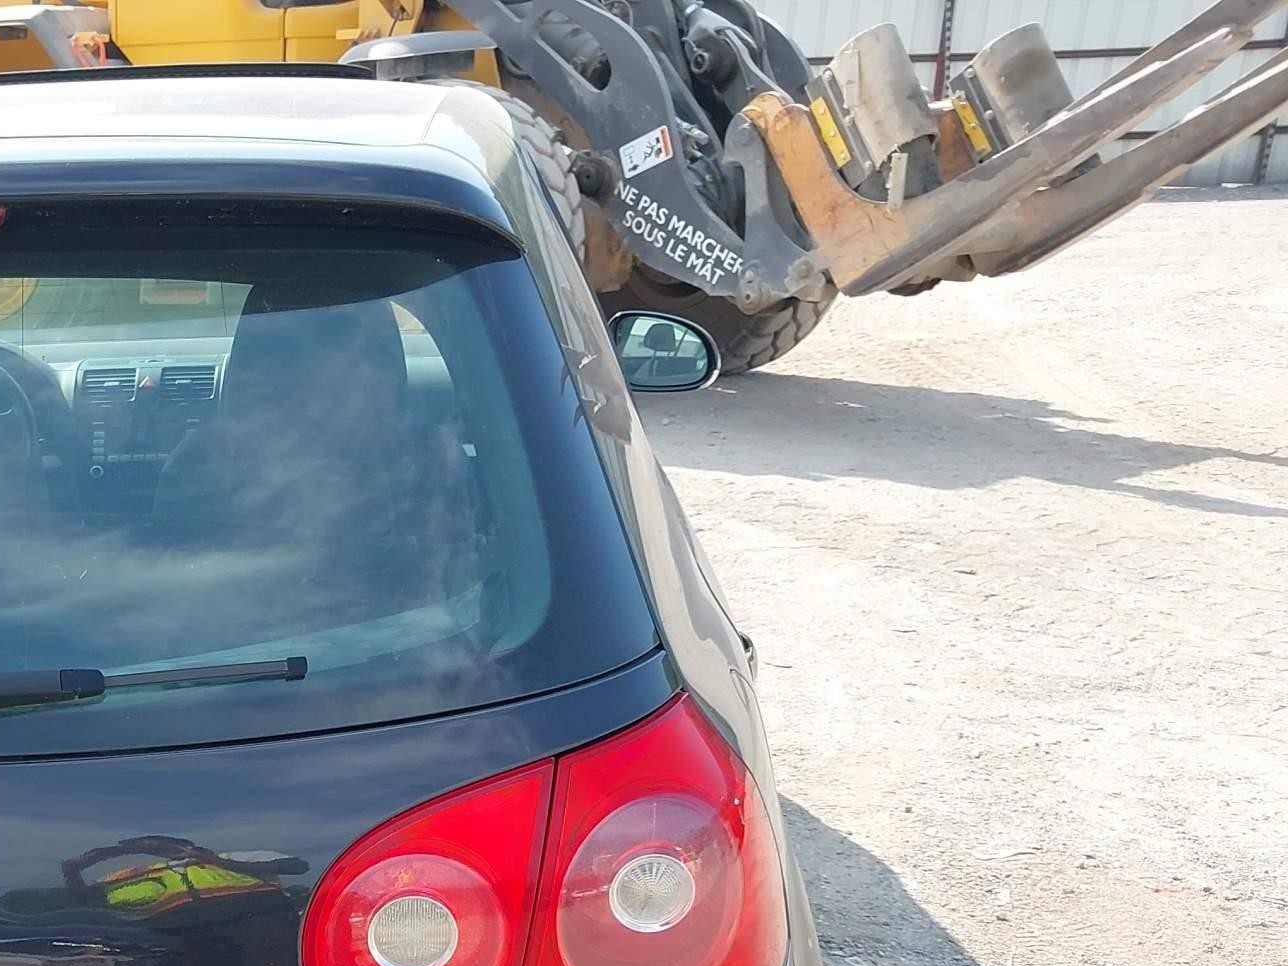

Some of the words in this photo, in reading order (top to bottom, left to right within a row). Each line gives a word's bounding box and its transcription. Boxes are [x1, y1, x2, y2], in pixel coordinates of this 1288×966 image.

[614, 180, 639, 206] NE
[637, 195, 669, 225] PAS
[622, 210, 667, 248] SOUS
[665, 238, 688, 262] LE
[686, 252, 725, 285] MÂT
